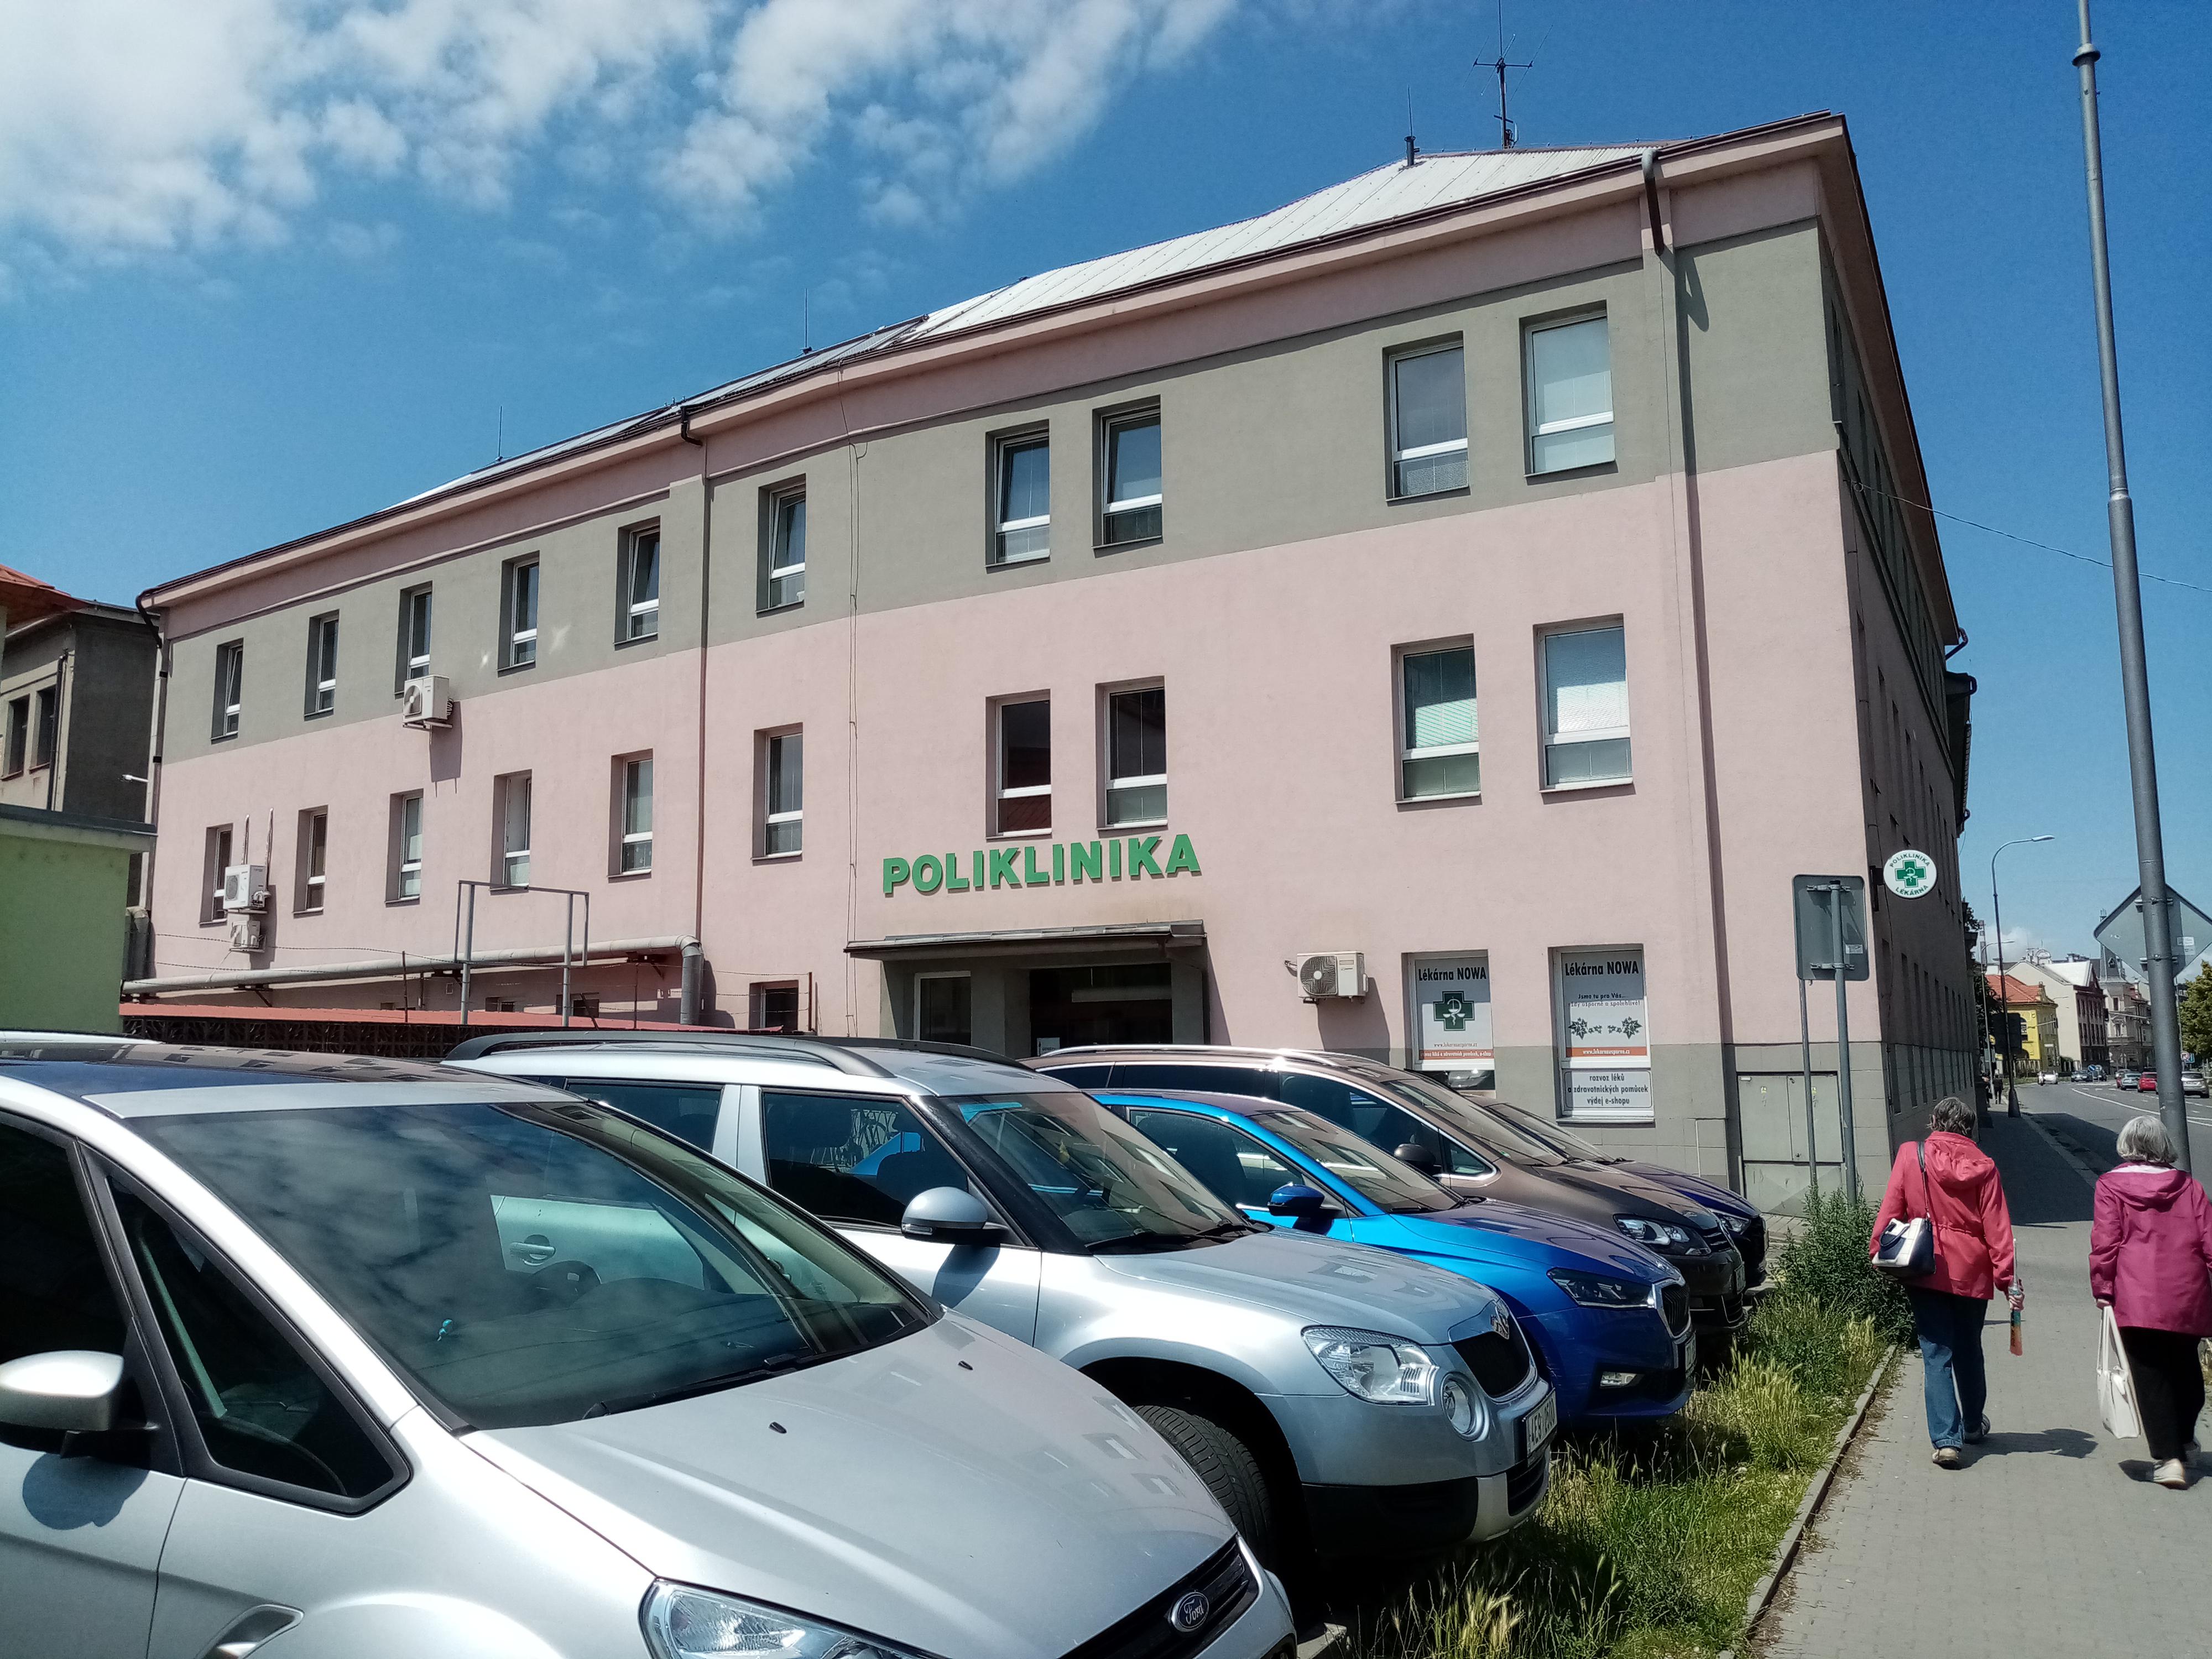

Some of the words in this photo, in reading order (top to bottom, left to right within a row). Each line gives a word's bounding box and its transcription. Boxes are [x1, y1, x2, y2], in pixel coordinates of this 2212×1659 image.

[883, 834, 1201, 894] POLIKLINIKA
[1890, 853, 1930, 867] POLIKLINIKA
[1896, 885, 1928, 895] LÉKÁRNA
[1418, 968, 1453, 981] Lékárna
[1457, 967, 1486, 980] NOWA
[1566, 962, 1603, 975] Lékárna
[1607, 961, 1639, 974] NOWA
[1611, 1073, 1625, 1081] léků
[1574, 1084, 1619, 1094] zdravotnických
[1621, 1084, 1648, 1094] pomůcek
[1587, 1097, 1603, 1105] výdej
[1605, 1096, 1630, 1105] e-shopu
[1184, 1599, 1204, 1625] Ford
